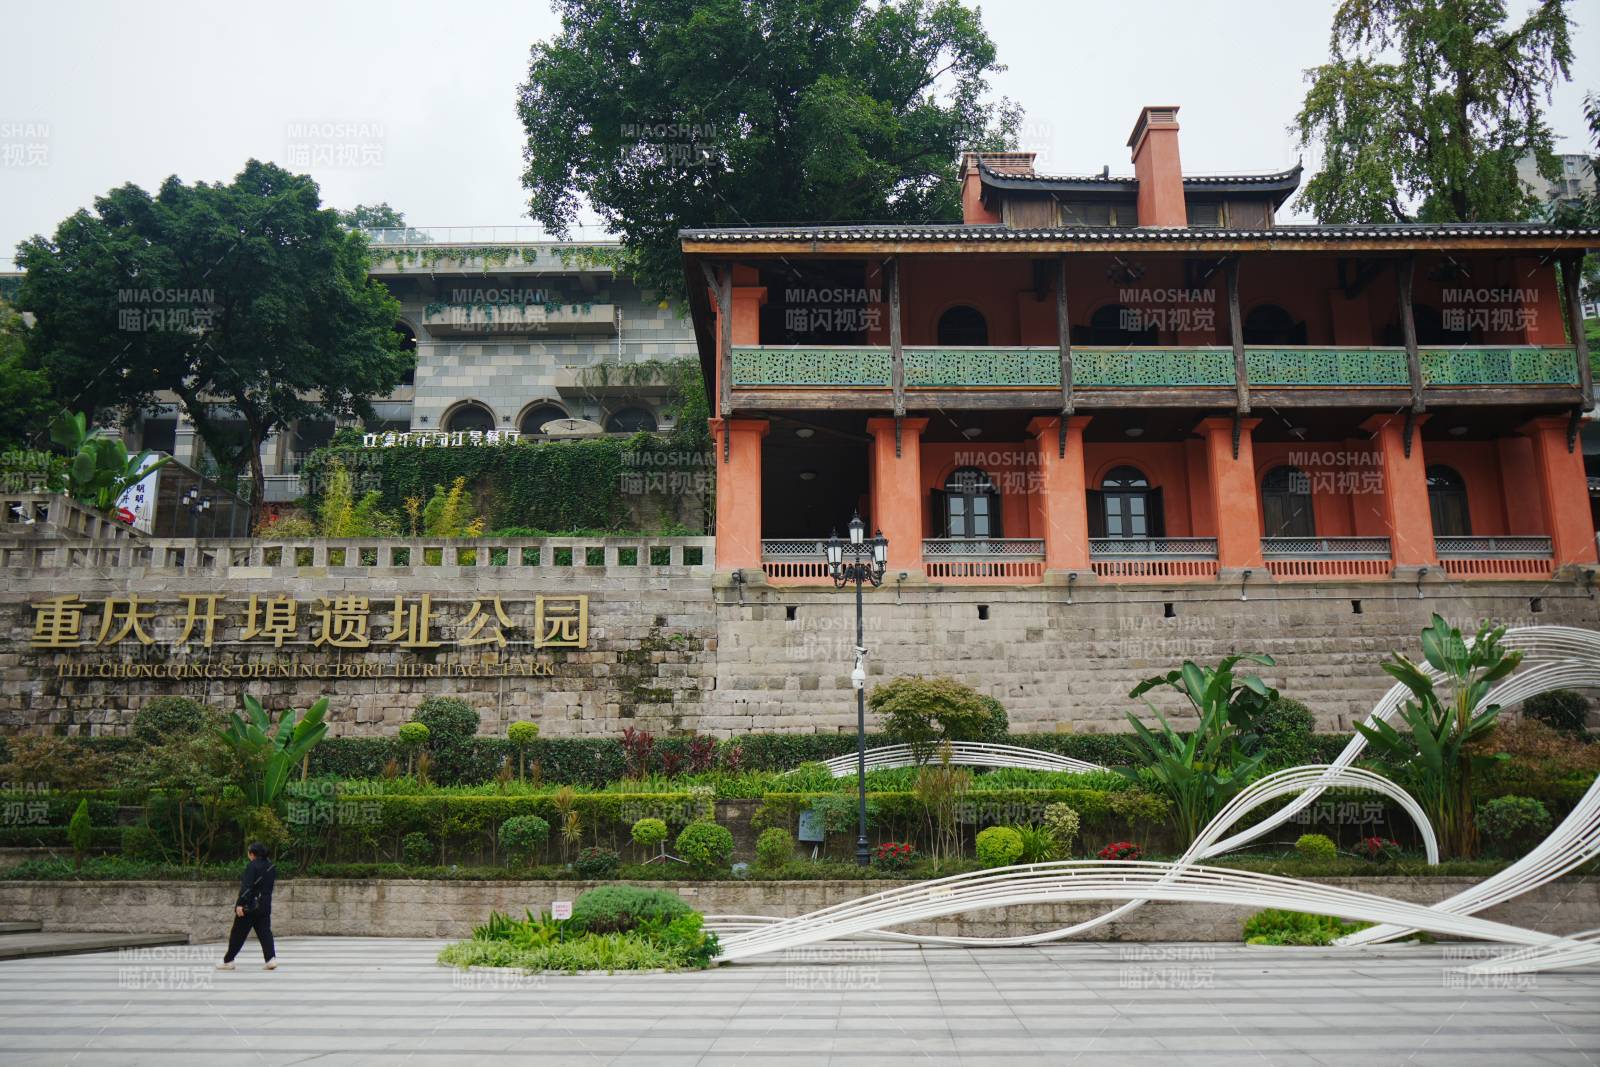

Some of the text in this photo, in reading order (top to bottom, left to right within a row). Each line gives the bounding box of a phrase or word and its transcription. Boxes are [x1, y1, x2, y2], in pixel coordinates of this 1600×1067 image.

[30, 593, 589, 649] 重庆开埠遗址公园
[57, 662, 555, 680] THE CHONGQING'S OPENING PORT HERITAGE PARK
